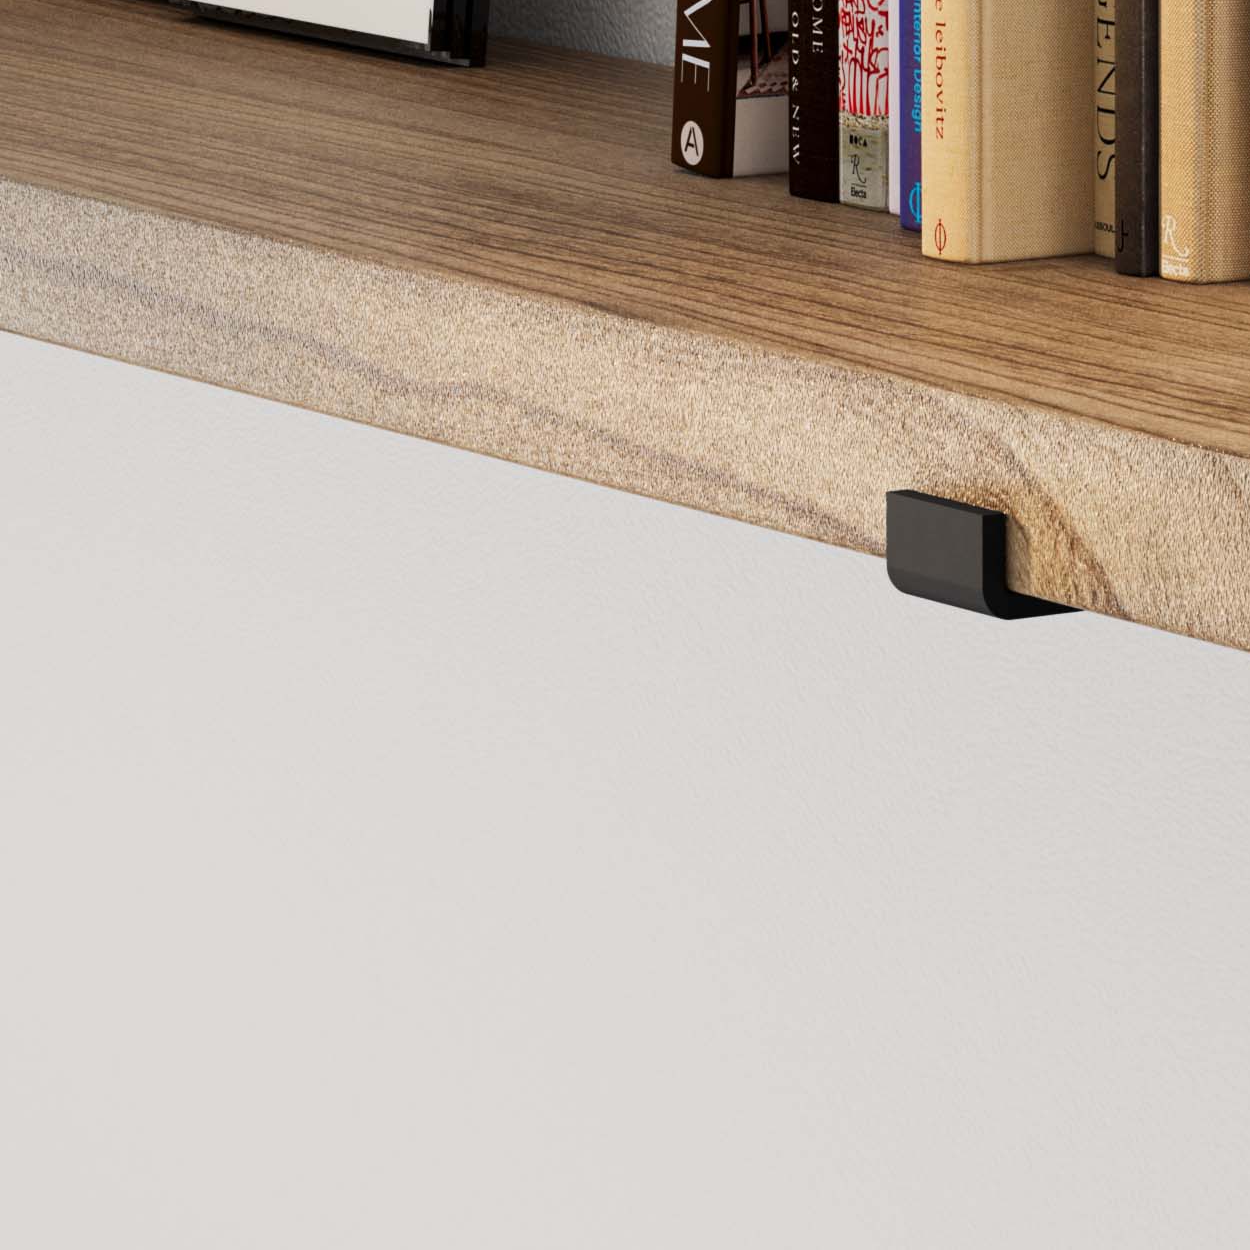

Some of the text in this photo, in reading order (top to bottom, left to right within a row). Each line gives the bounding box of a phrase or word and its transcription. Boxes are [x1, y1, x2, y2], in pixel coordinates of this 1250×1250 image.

[791, 11, 799, 65] OLD
[791, 76, 799, 92] &
[934, 19, 946, 140] leibovitz
[791, 104, 800, 165] NEW
